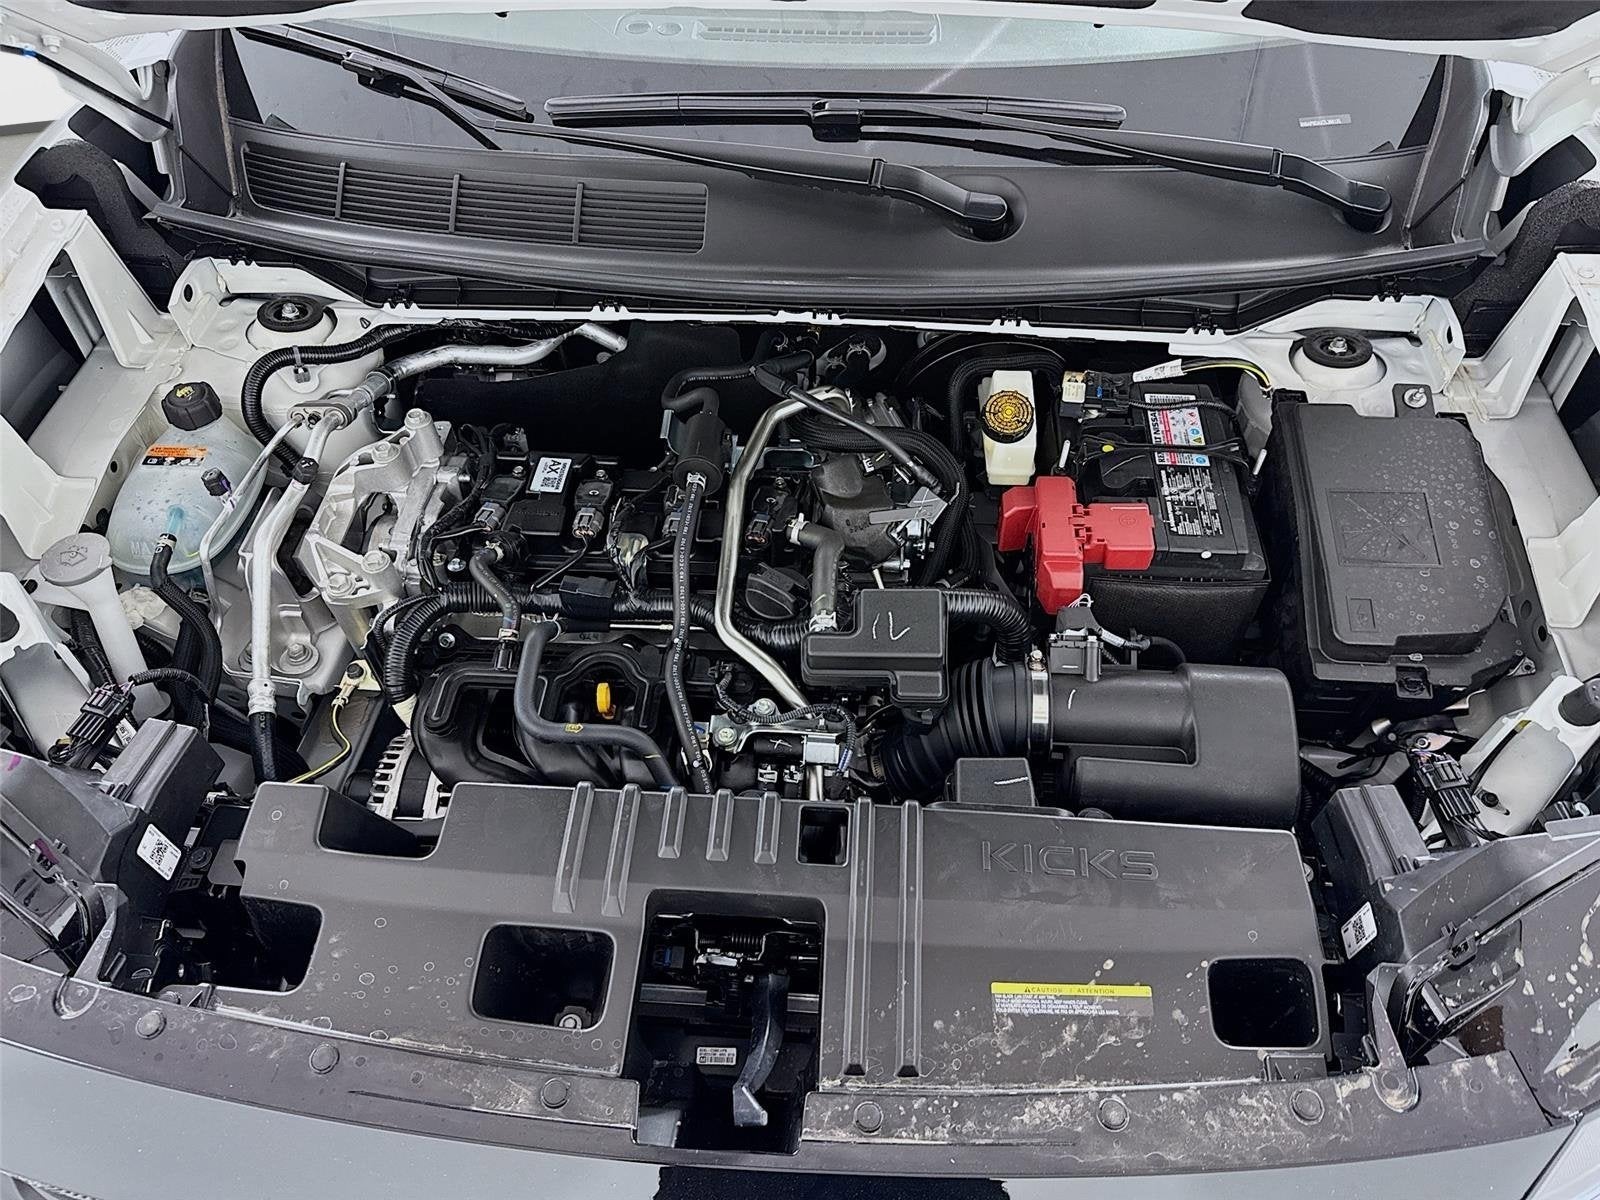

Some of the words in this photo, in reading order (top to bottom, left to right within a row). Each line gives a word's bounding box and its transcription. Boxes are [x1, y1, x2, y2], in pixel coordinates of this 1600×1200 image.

[1149, 409, 1161, 435] NISSA
[547, 459, 562, 474] AX
[981, 840, 1160, 881] KICKS
